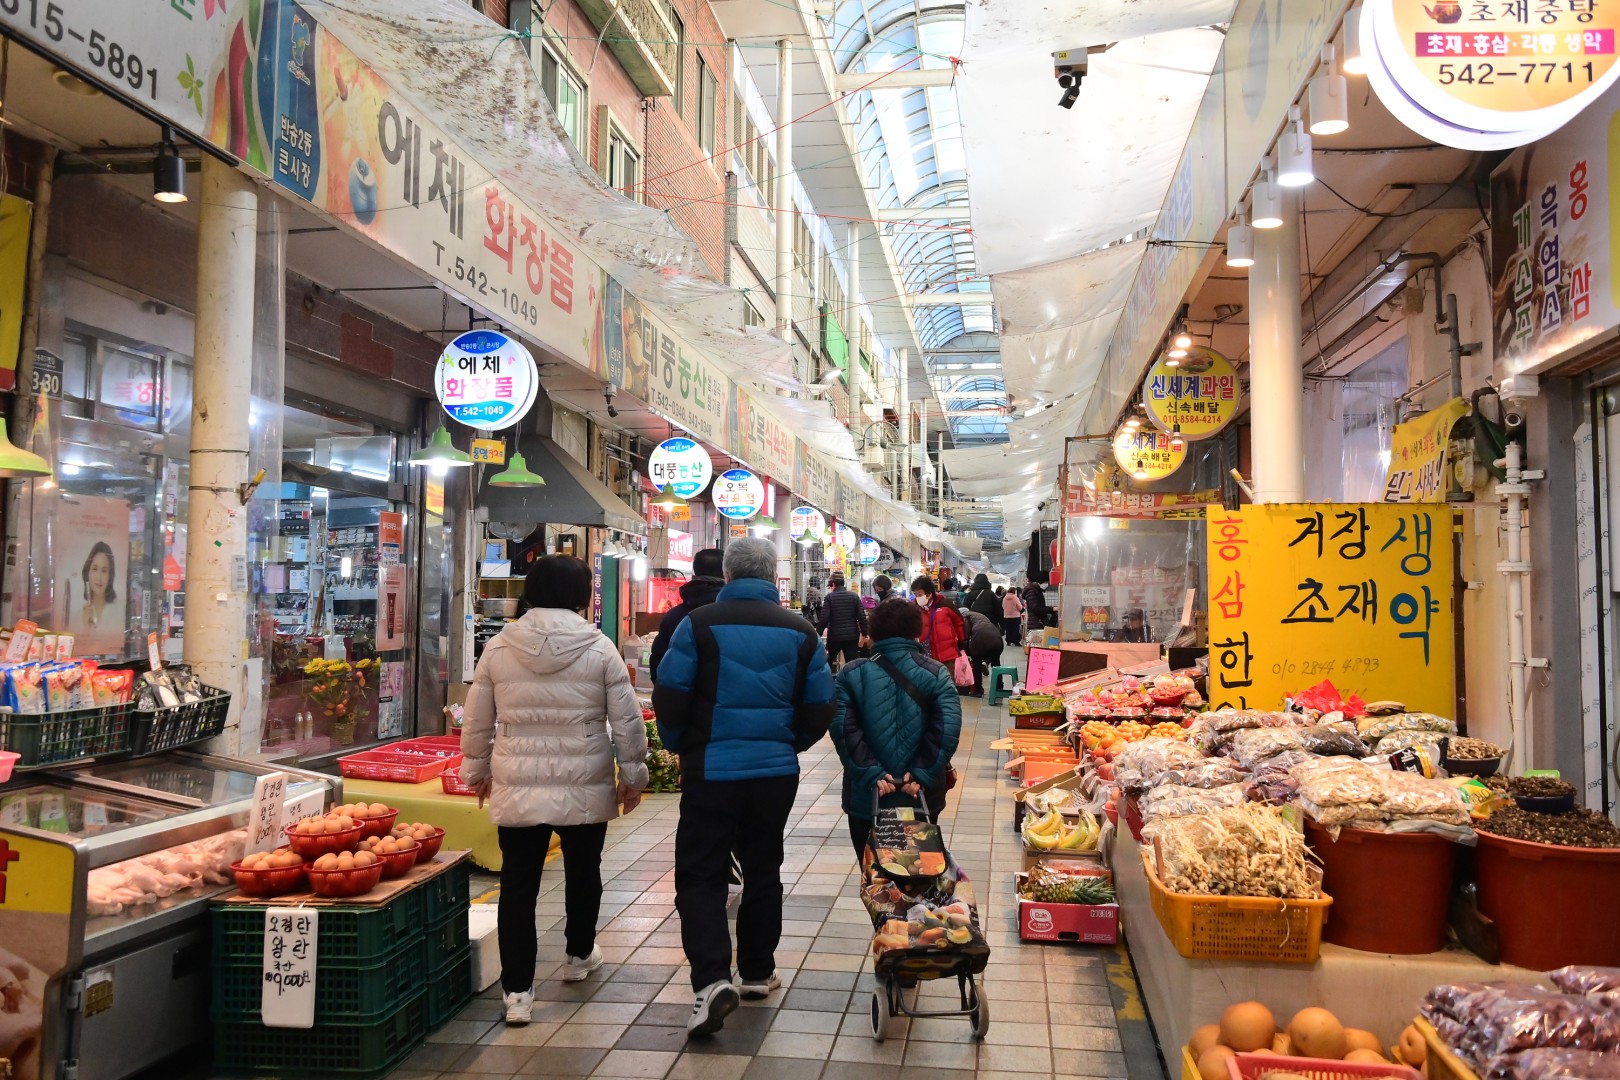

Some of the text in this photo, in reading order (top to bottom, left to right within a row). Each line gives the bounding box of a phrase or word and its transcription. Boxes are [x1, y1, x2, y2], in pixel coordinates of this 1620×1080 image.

[1564, 33, 1603, 53] 생약
[1438, 61, 1594, 85] 542-7711
[281, 115, 312, 157] 반송2동
[279, 147, 311, 189] 큰시장
[378, 101, 465, 241] 에체
[483, 186, 574, 315] 화장품
[1568, 160, 1591, 322] 홍삼
[1540, 184, 1560, 331] 흑염소
[432, 240, 538, 326] T.542-1049
[1513, 205, 1532, 350] 개소주
[458, 355, 500, 375] 에체
[642, 316, 707, 410] 대풍농산
[32, 371, 59, 394] 3-30
[446, 376, 513, 400] 화장품
[1150, 375, 1235, 400] 신세계과일
[454, 405, 504, 416] T.542-1049
[1163, 415, 1222, 424] 010-8584-4214
[1166, 401, 1220, 414] 신속배달
[748, 405, 788, 465] 오복식육점
[1131, 452, 1171, 462] 신속배달
[654, 461, 703, 480] 대풍농산
[718, 493, 755, 505] 식육점
[725, 482, 748, 492] 오복
[792, 515, 818, 527] 족발
[1288, 508, 1370, 560] 거창
[1212, 515, 1249, 619] 홍삼
[1281, 577, 1378, 625] 초재
[1381, 512, 1440, 667] 생약
[1272, 659, 1296, 680] 010
[1302, 660, 1335, 675] 2844
